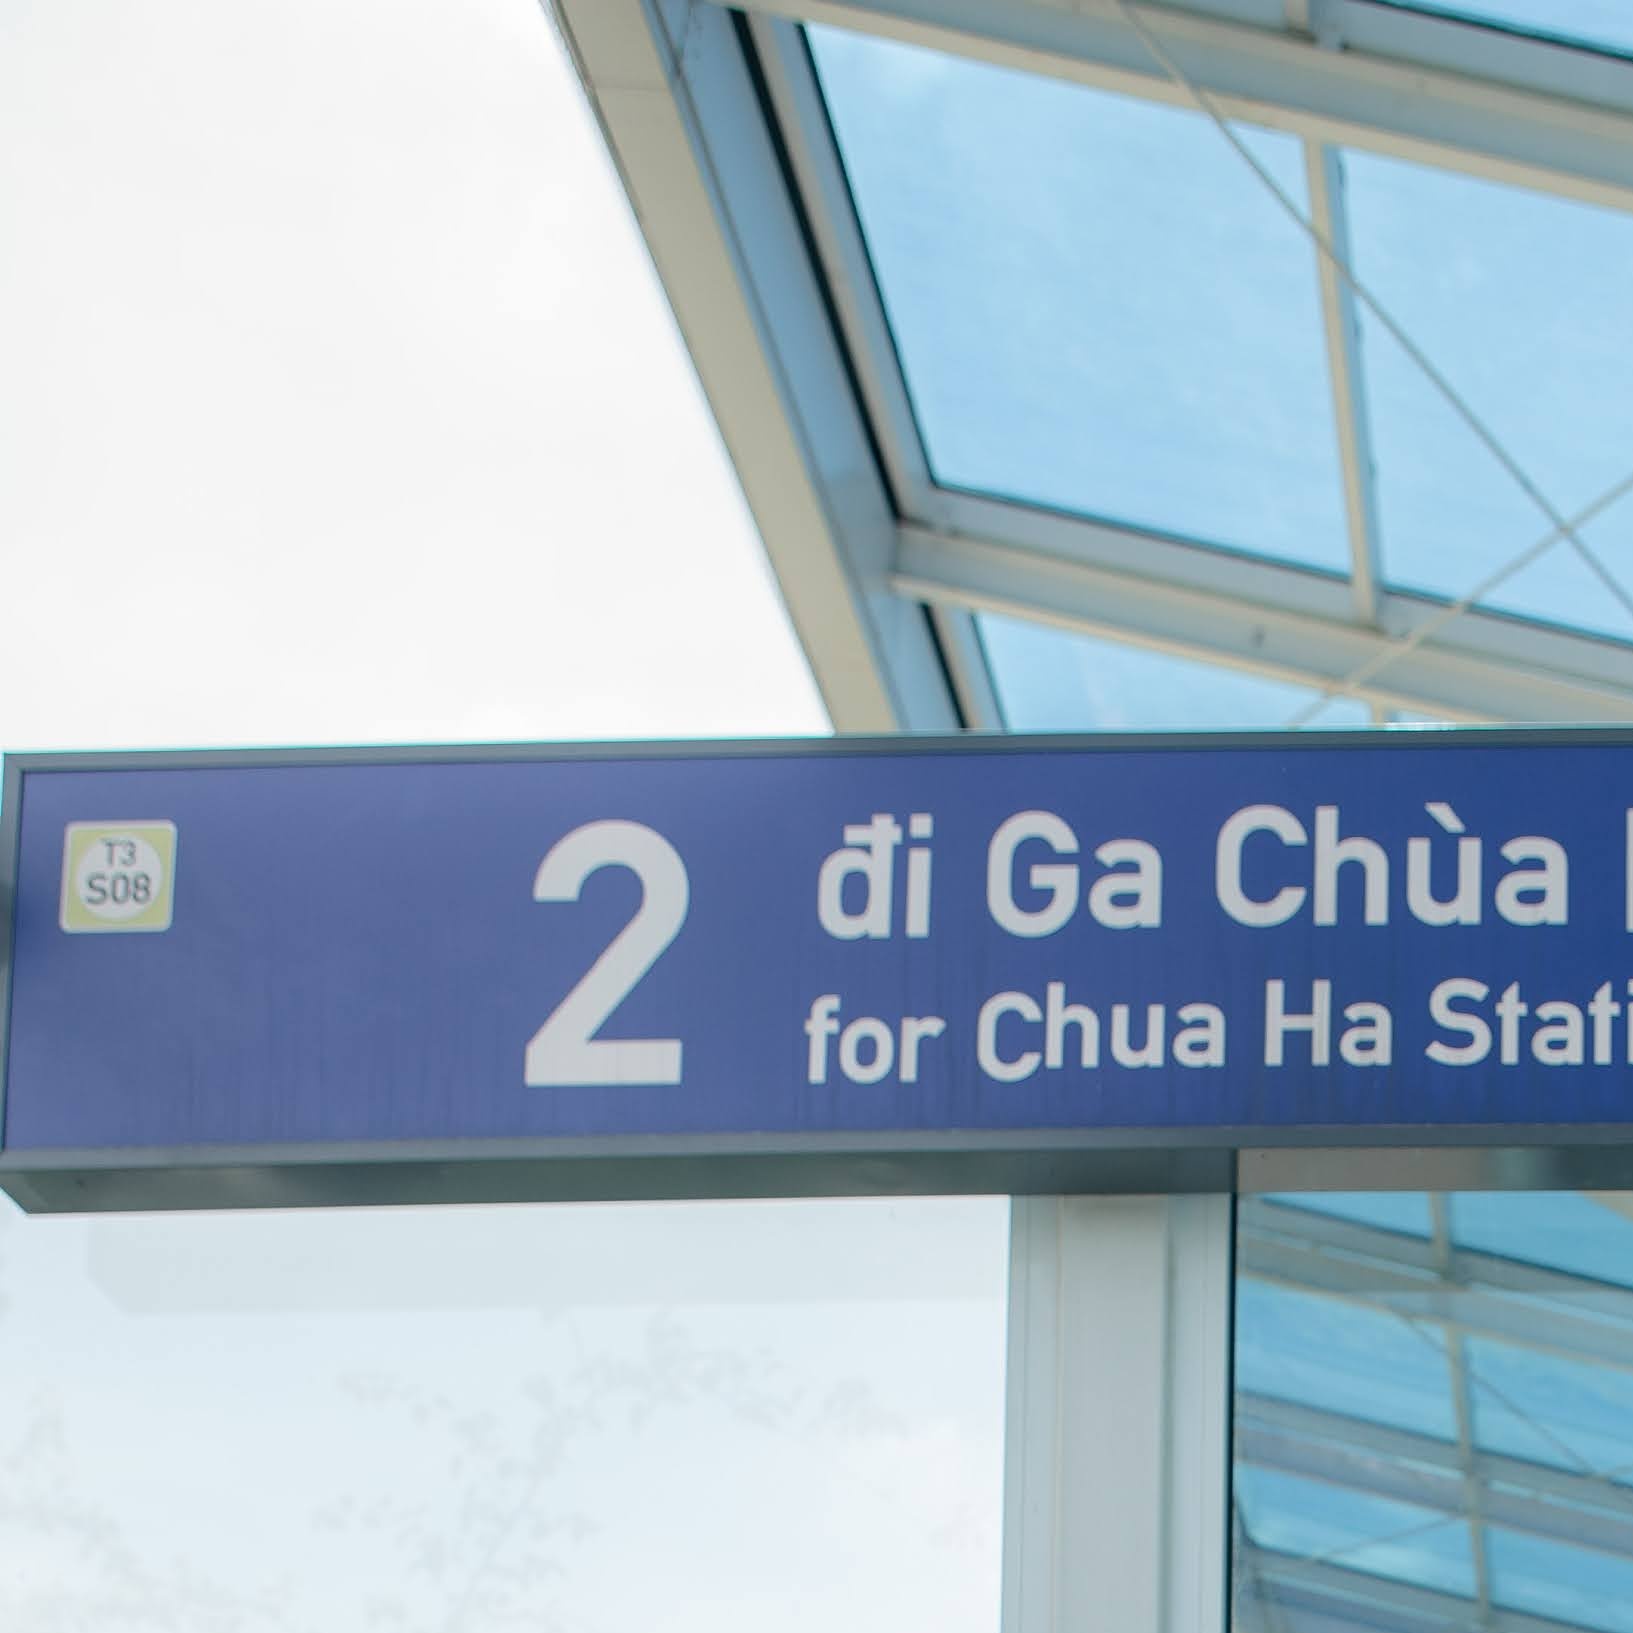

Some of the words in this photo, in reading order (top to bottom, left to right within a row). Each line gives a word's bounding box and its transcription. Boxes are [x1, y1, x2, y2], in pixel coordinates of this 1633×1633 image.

[85, 871, 152, 905] S08
[101, 838, 137, 867] T3
[818, 812, 933, 937] đi
[987, 810, 1160, 936] Ga
[1216, 802, 1568, 925] Chùa
[523, 819, 689, 1086] 2
[804, 994, 945, 1083] for
[977, 981, 1225, 1081] Chua
[1264, 979, 1391, 1065] Ha
